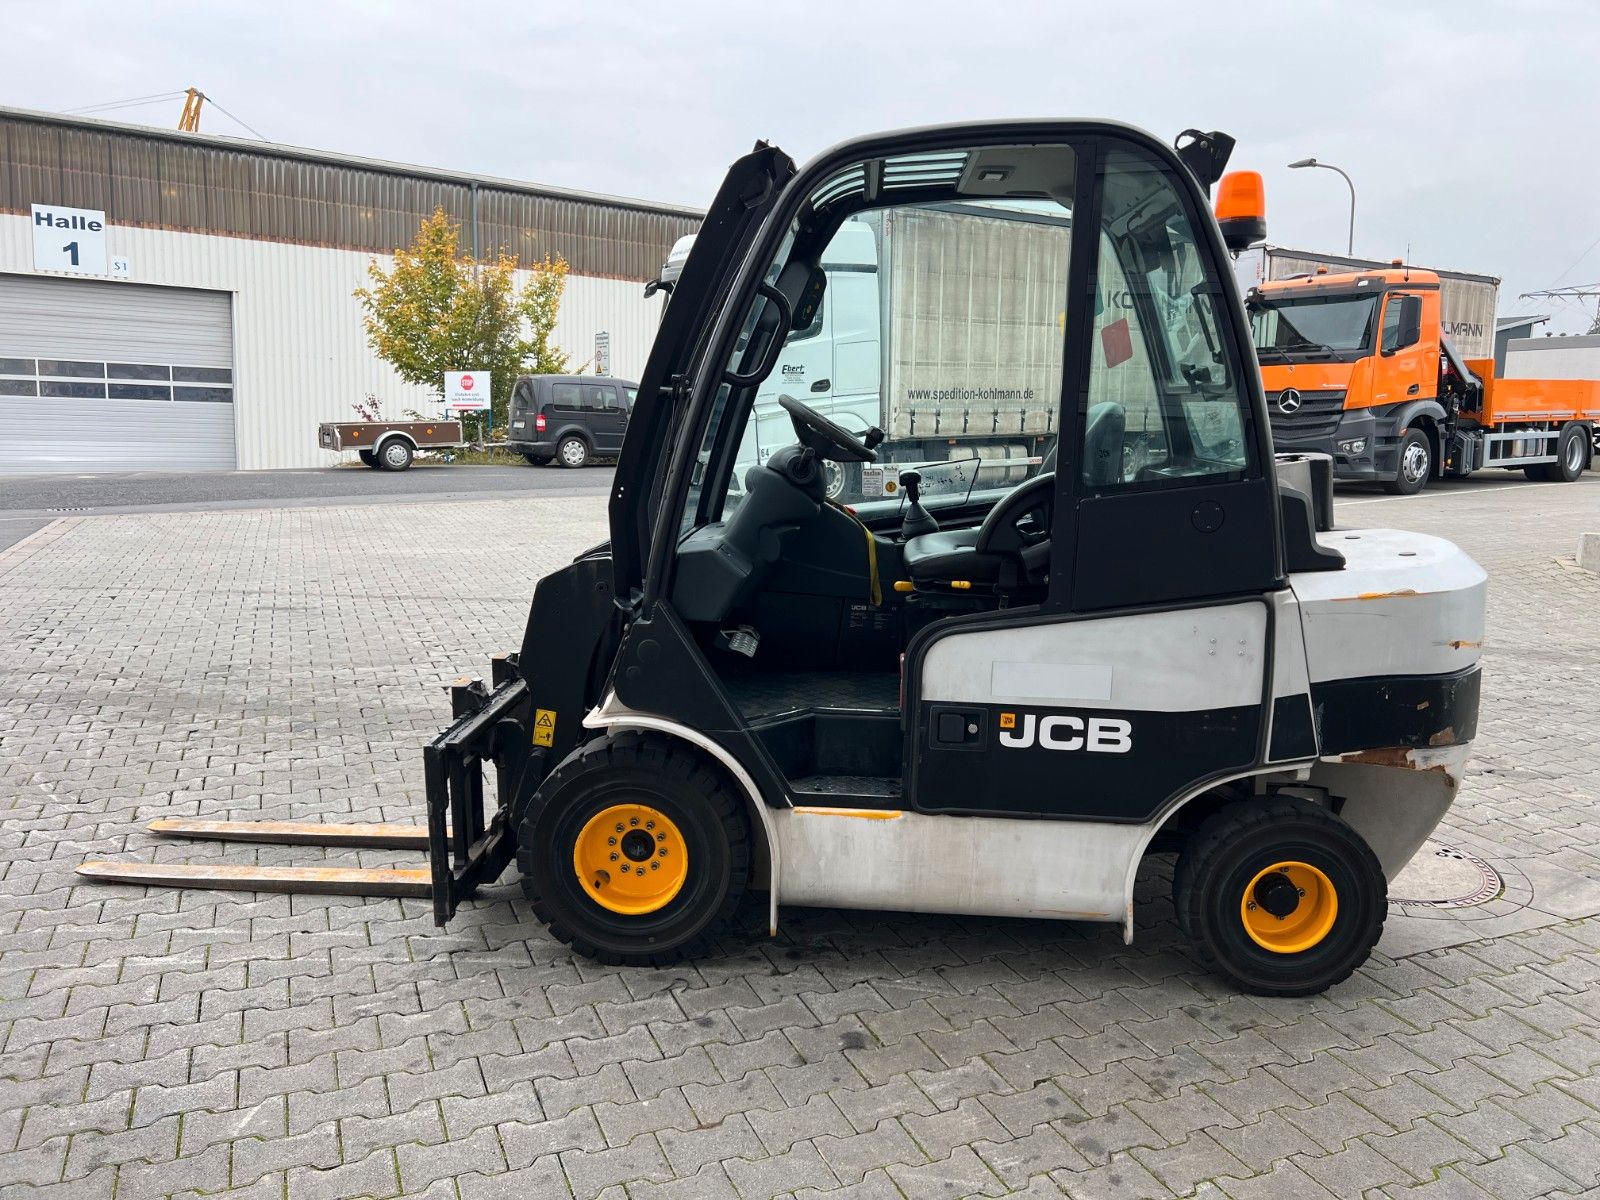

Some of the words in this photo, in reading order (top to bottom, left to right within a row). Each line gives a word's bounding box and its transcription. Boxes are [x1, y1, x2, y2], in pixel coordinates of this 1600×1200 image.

[35, 211, 103, 232] Halle
[63, 241, 79, 266] 1
[1441, 320, 1483, 337] LMANN
[781, 364, 805, 374] Ebert
[907, 387, 1034, 403] www.spedition-kohlmann.de
[1000, 714, 1132, 753] JCB
